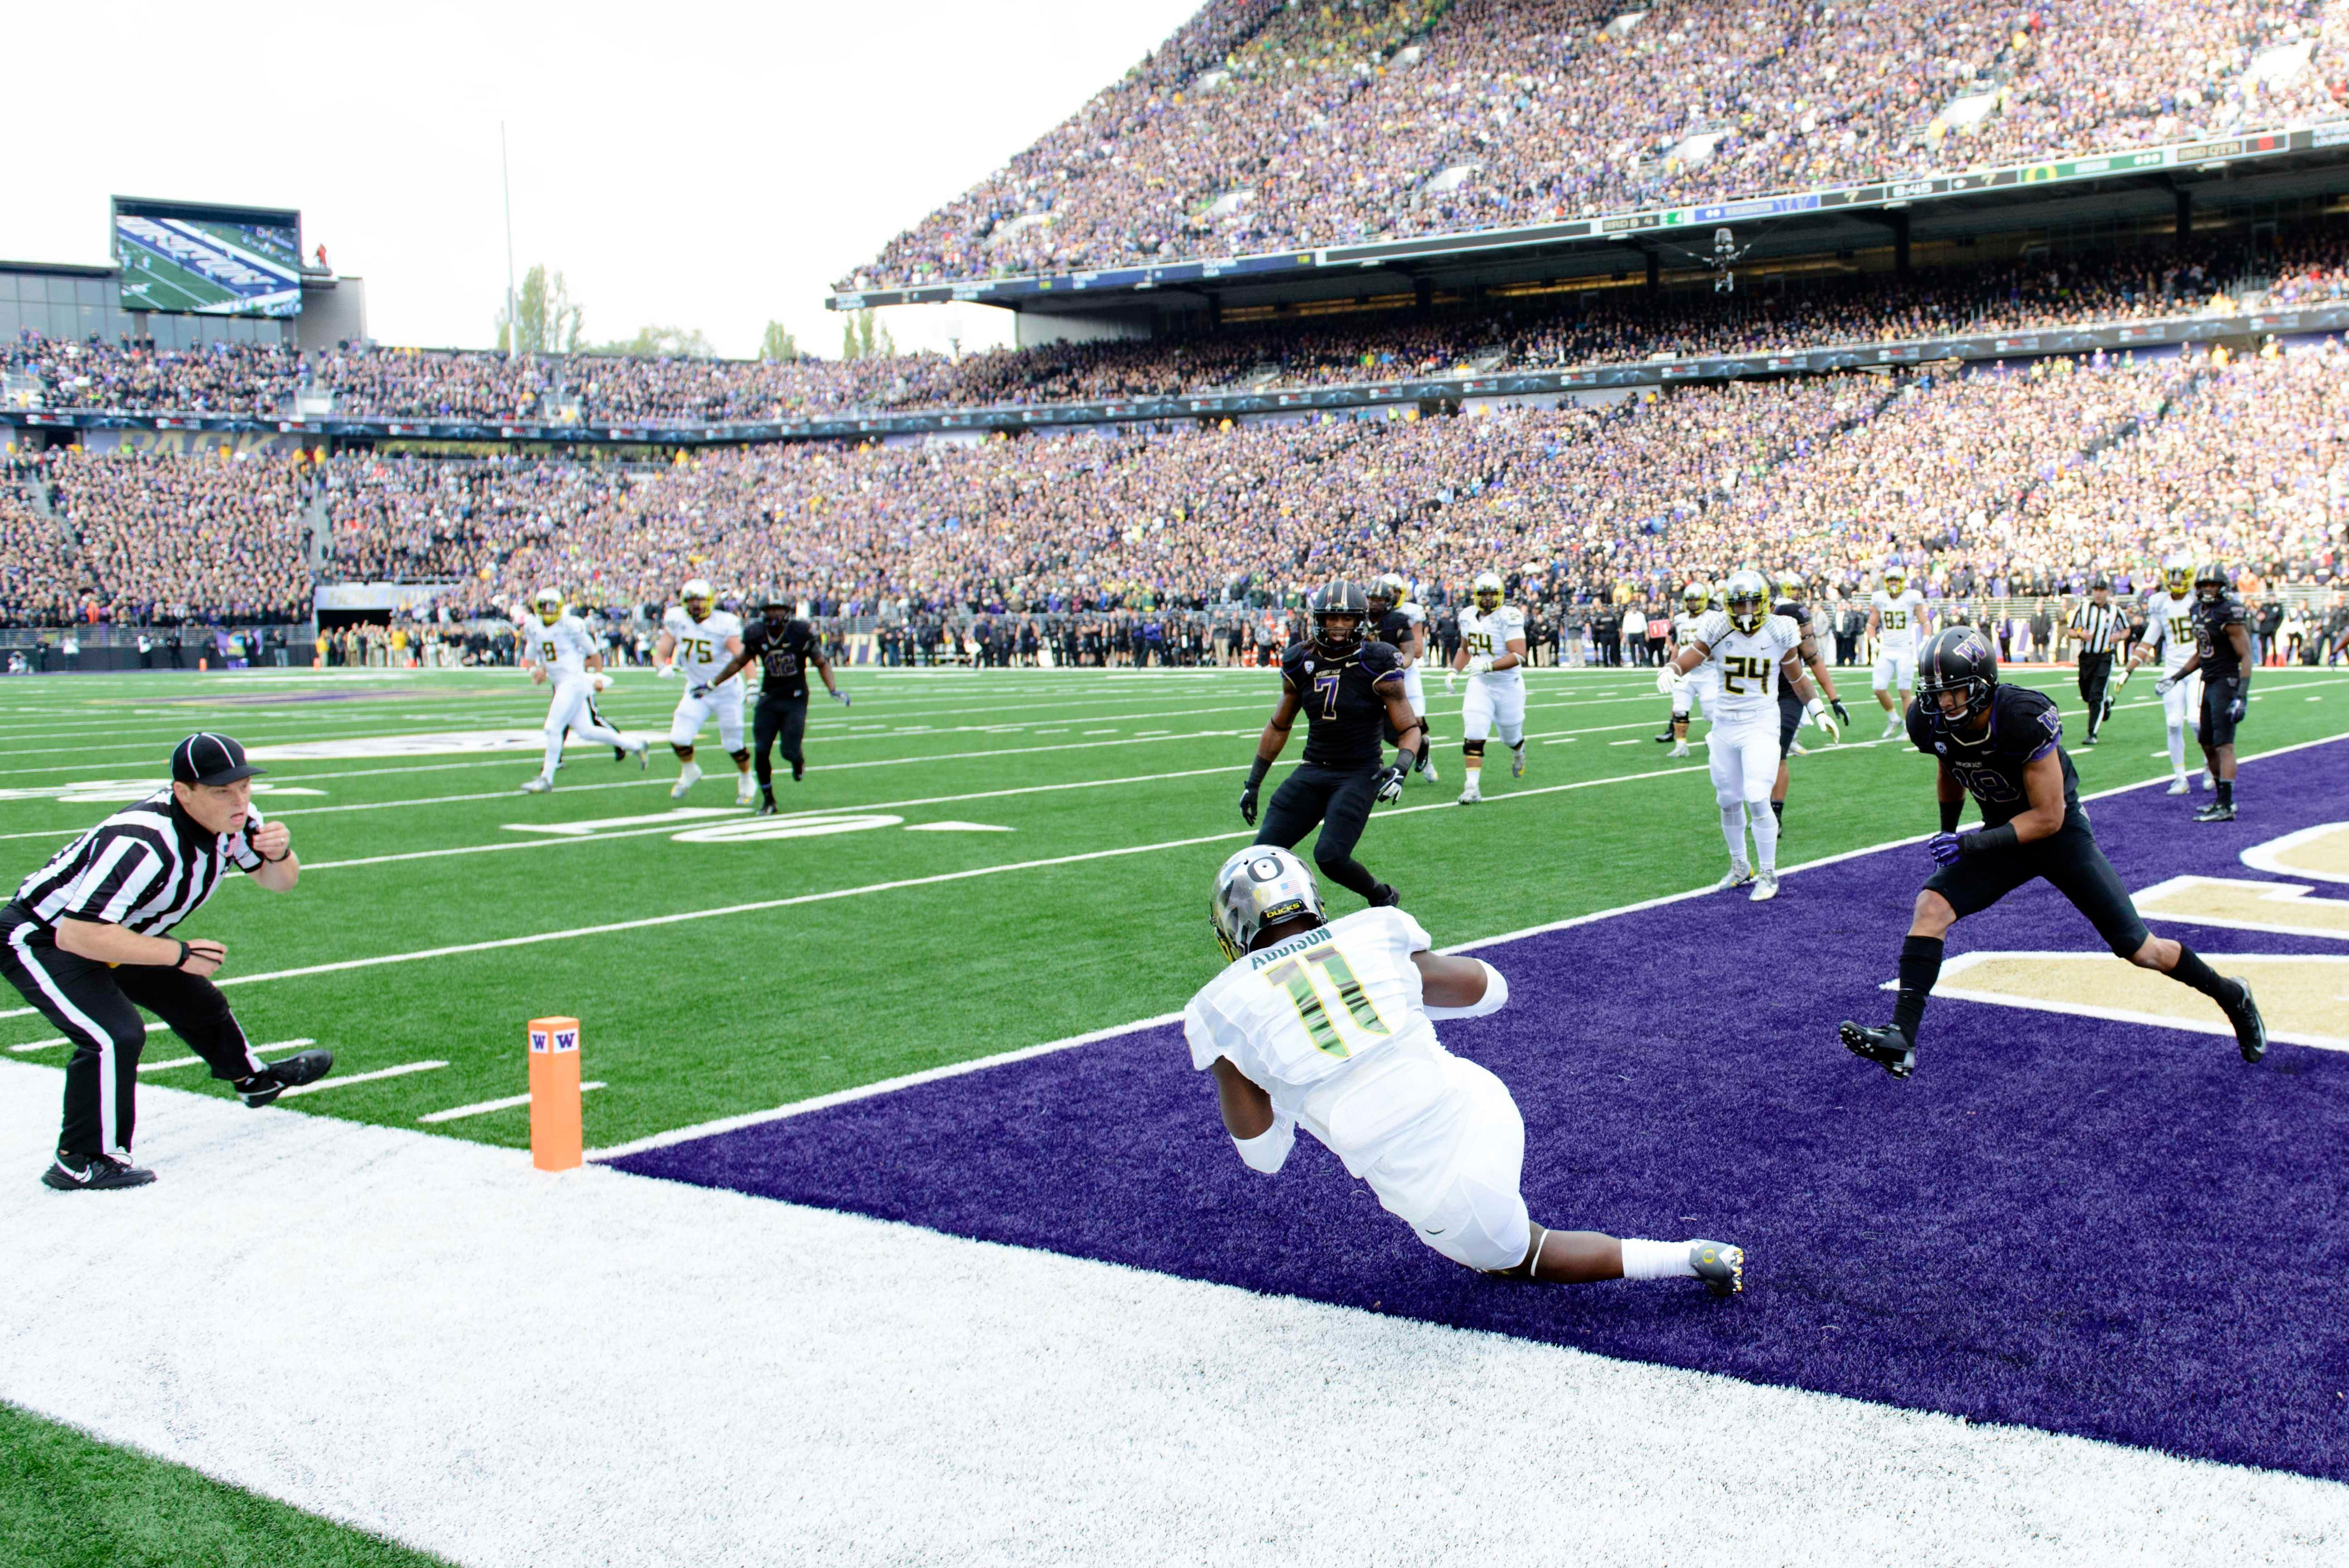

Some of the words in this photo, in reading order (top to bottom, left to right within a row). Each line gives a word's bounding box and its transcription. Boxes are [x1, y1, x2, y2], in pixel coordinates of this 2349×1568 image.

[2208, 141, 2241, 156] QTR
[1981, 173, 1997, 187] 7
[1844, 190, 1860, 203] 7
[1643, 216, 1654, 225] 4
[1675, 212, 1682, 222] 4
[1885, 611, 1905, 630] 83
[2168, 616, 2194, 645] 16
[542, 642, 557, 662] 8
[681, 637, 714, 664] 75
[1467, 631, 1496, 657] 54
[1953, 633, 1986, 664] W
[764, 649, 798, 678] 42
[1724, 655, 1771, 695] 24
[1314, 674, 1340, 720] 7
[1952, 768, 2022, 803] 18
[1266, 902, 1301, 919] DUCKS
[1251, 927, 1333, 971] ADDISON
[1262, 943, 1392, 1059] 11
[532, 1034, 546, 1049] W
[556, 1032, 576, 1048] W
